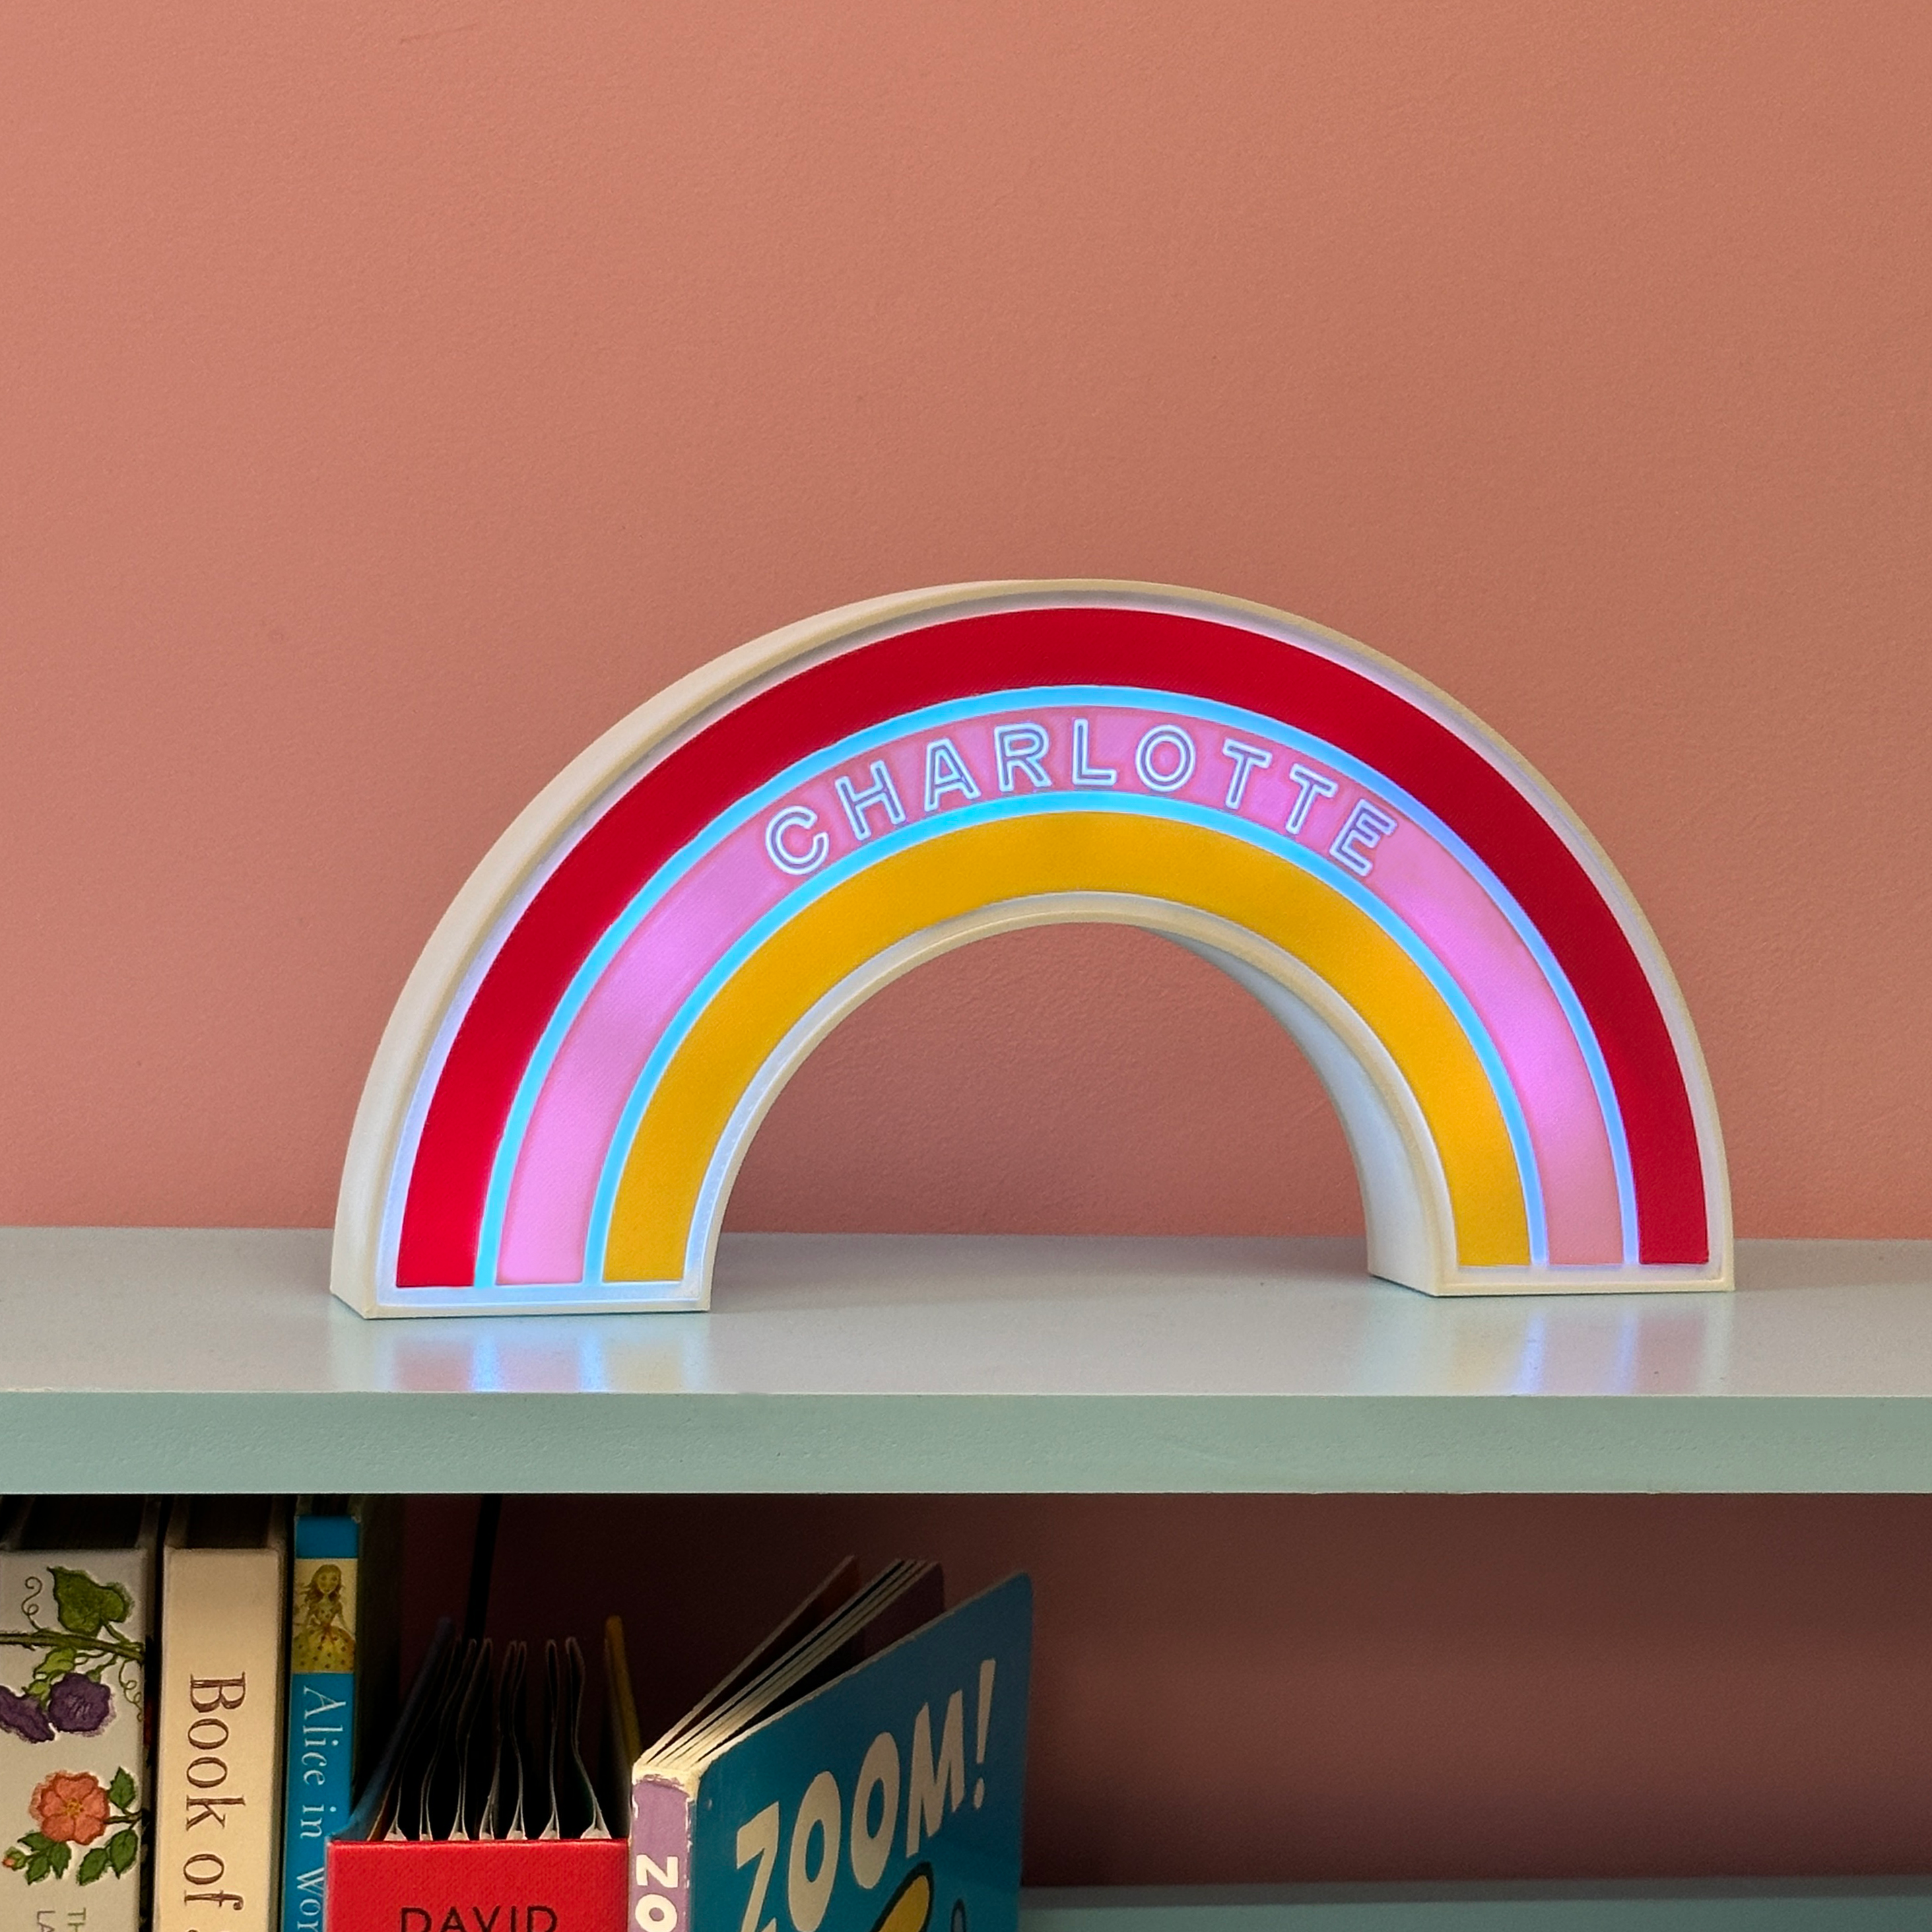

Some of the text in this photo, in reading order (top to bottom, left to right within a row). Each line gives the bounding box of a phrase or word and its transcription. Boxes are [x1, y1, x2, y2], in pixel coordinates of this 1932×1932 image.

[765, 718, 1397, 877] CHARLOTTE
[302, 1685, 347, 1785] Alice
[182, 1671, 246, 1910] Book of
[300, 1804, 337, 1839] in
[735, 1659, 996, 1932] ZOOM!
[401, 1905, 558, 1932] DAVID
[635, 1854, 678, 1932] ZO
